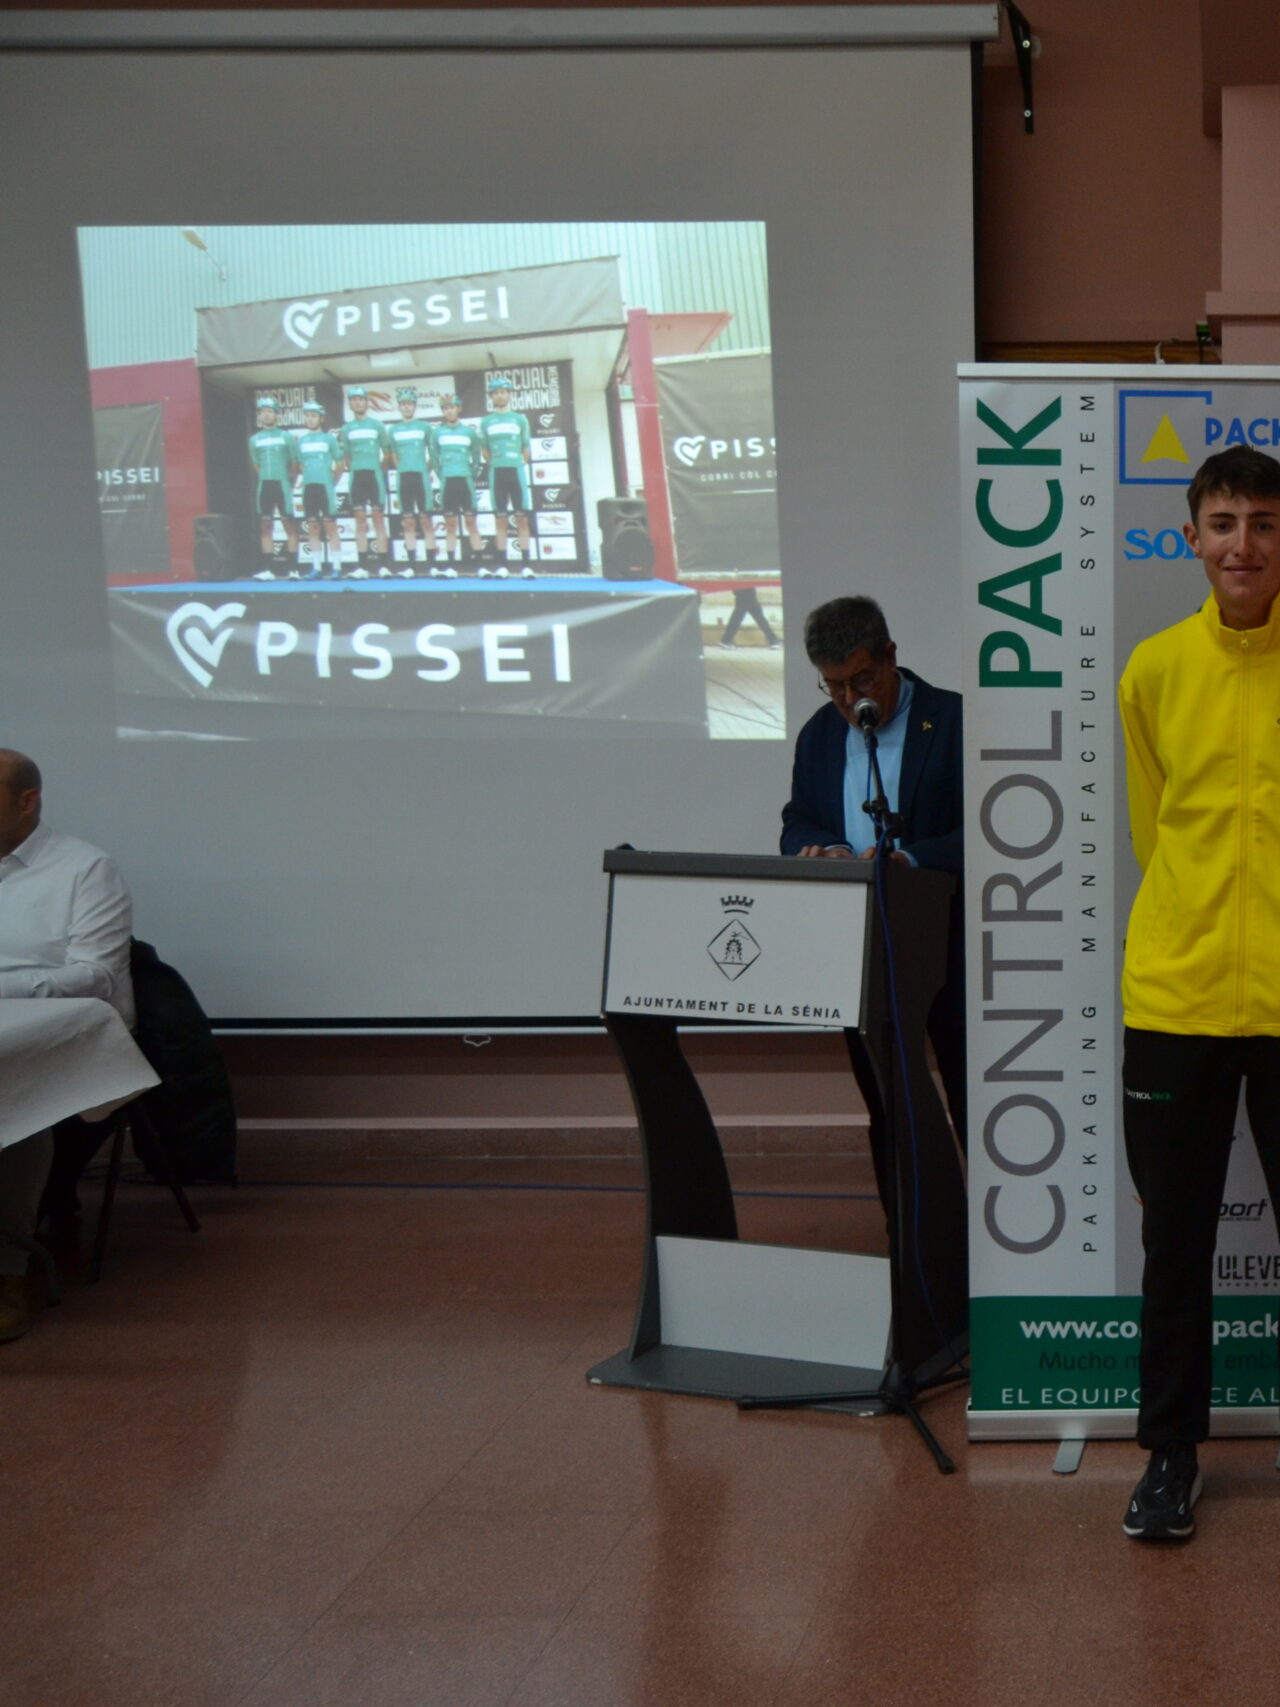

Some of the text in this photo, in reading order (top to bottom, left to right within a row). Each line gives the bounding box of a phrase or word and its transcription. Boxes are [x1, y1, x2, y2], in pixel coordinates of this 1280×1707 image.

[336, 286, 510, 337] PISSEI
[255, 621, 571, 682] PISSEI
[1080, 395, 1098, 1253] PACKAGING MANUFACTURE SYSTEM
[623, 995, 841, 1019] AJUNTAMENT DE LA SÉNIA
[1039, 1350, 1117, 1370] Mucho
[1002, 1388, 1031, 1404] EL
